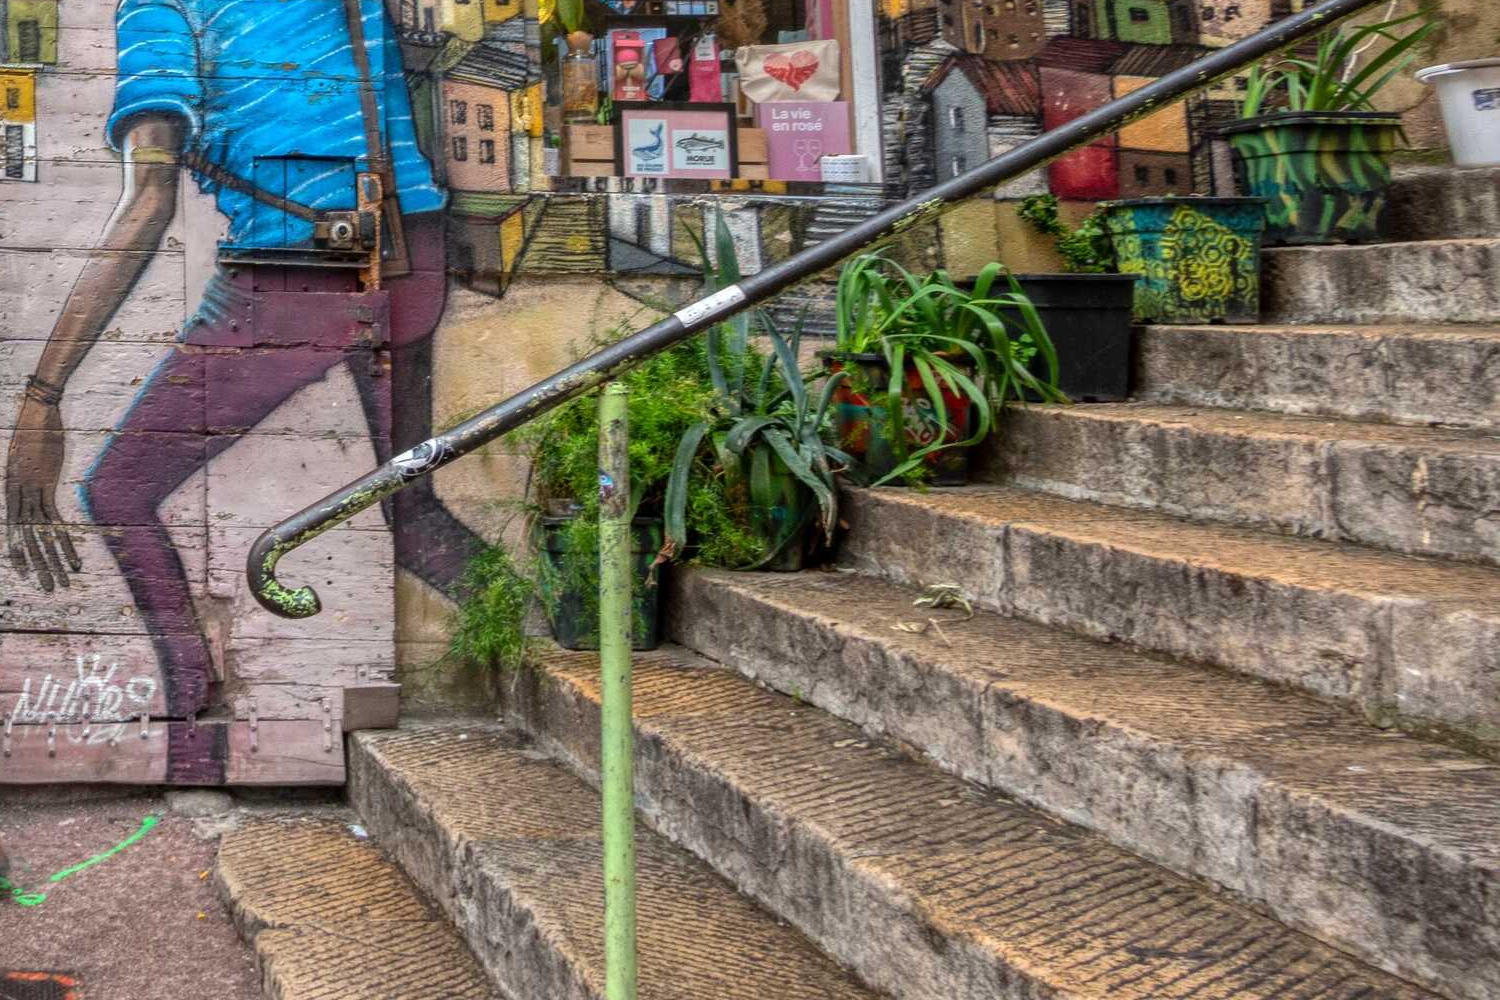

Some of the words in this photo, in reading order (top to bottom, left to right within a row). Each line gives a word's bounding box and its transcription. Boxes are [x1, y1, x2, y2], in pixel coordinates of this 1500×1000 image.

[771, 107, 789, 120] La
[790, 107, 812, 120] vie
[771, 121, 790, 132] en
[791, 118, 823, 132] rosé
